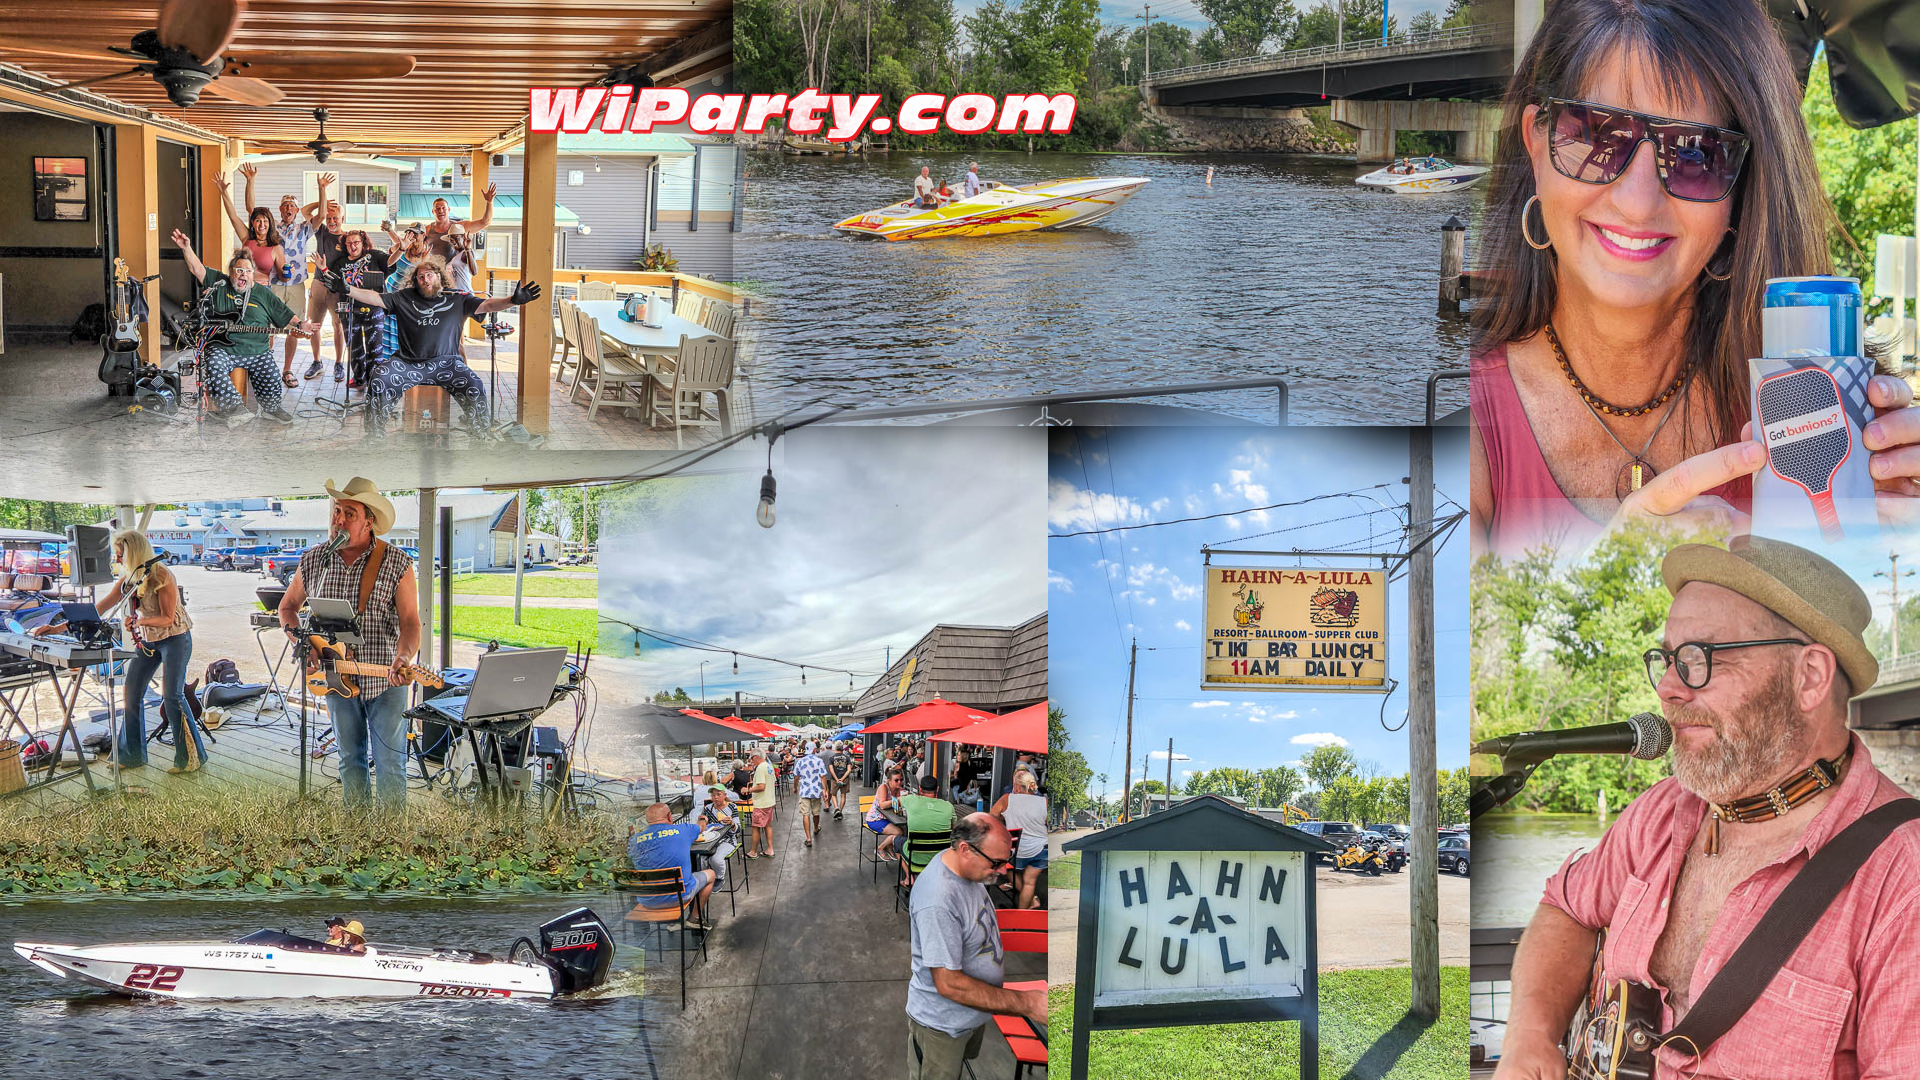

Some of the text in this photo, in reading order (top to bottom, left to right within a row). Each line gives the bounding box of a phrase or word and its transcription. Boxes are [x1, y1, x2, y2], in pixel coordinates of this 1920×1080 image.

[1769, 413, 1838, 441] Got bunions?
[1355, 630, 1379, 639] CLUB
[1212, 641, 1373, 659] TIKI BAR LUNCH
[1231, 659, 1363, 677] 11AM DAILY
[637, 829, 680, 844] EST. 1984
[1119, 860, 1287, 908] HAHN
[550, 929, 598, 949] 300
[204, 950, 222, 958] WS
[225, 951, 249, 959] 1757
[1118, 926, 1290, 975] LULA
[375, 959, 424, 973] Racing
[124, 963, 185, 992] 22
